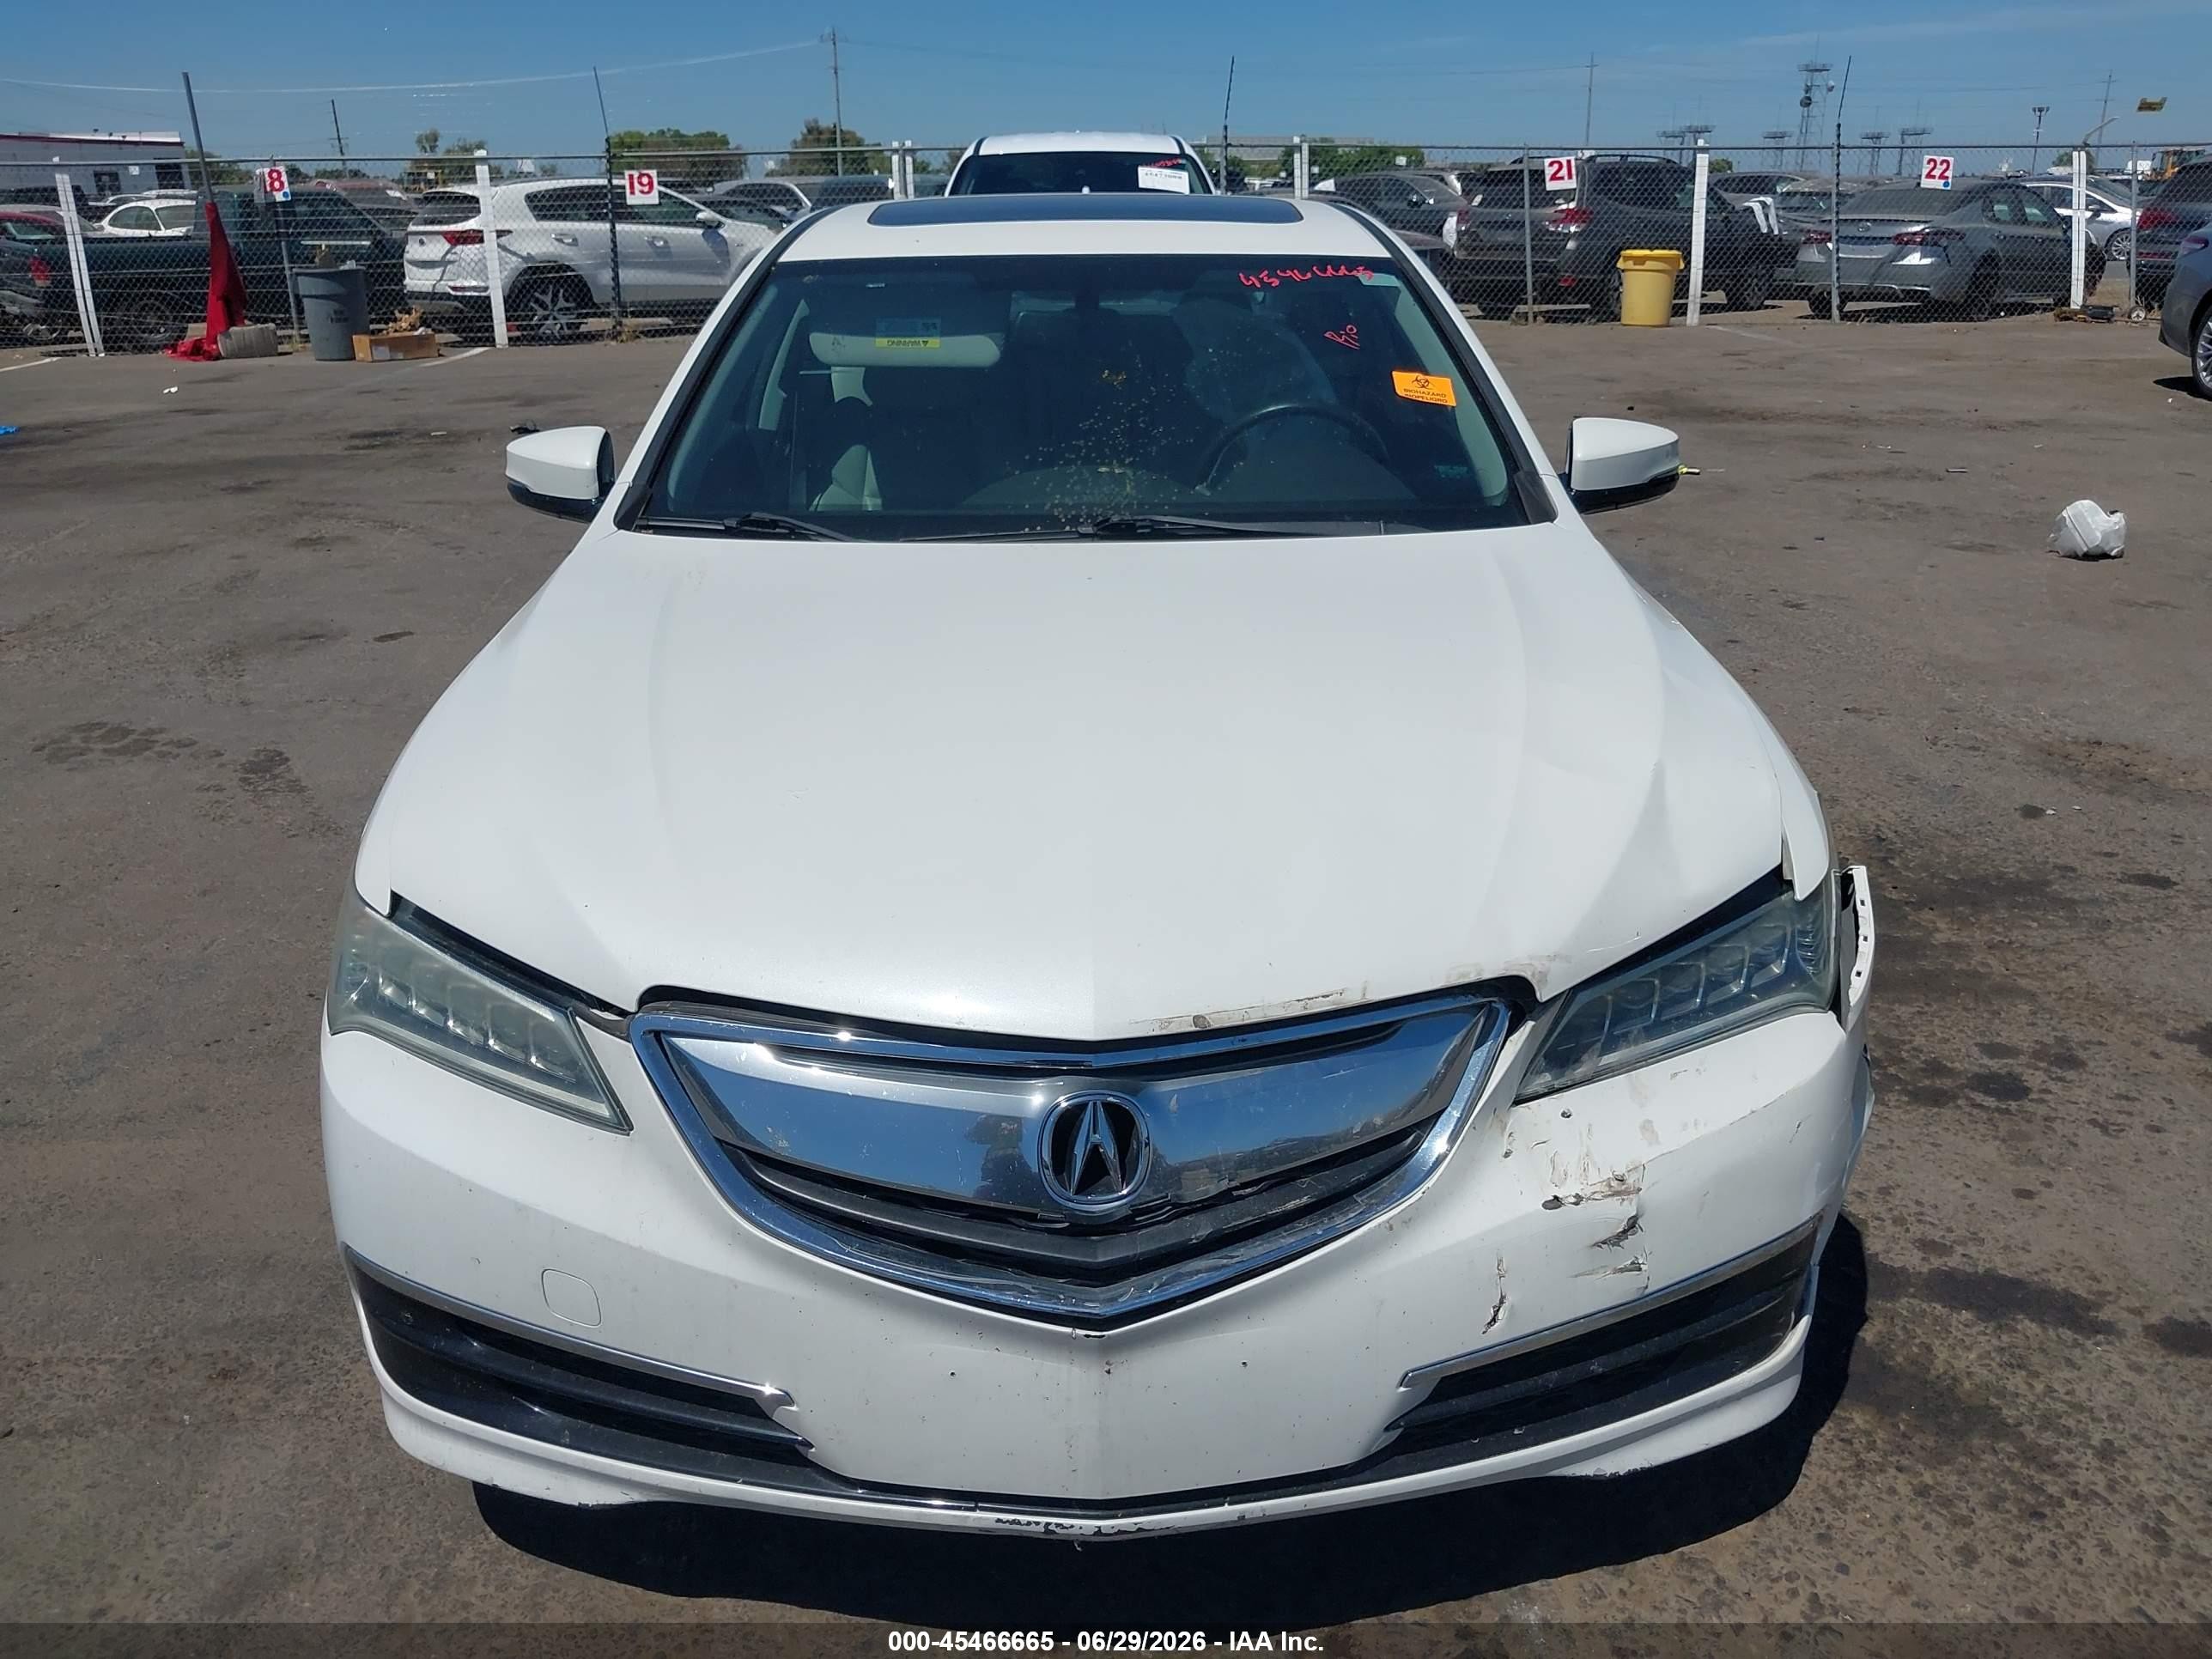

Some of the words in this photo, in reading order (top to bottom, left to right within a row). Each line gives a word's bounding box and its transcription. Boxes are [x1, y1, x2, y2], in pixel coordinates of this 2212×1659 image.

[1548, 159, 1573, 181] 21
[1924, 158, 1950, 180] 22
[629, 173, 654, 195] 19
[1403, 388, 1447, 398] BIOHAZARD
